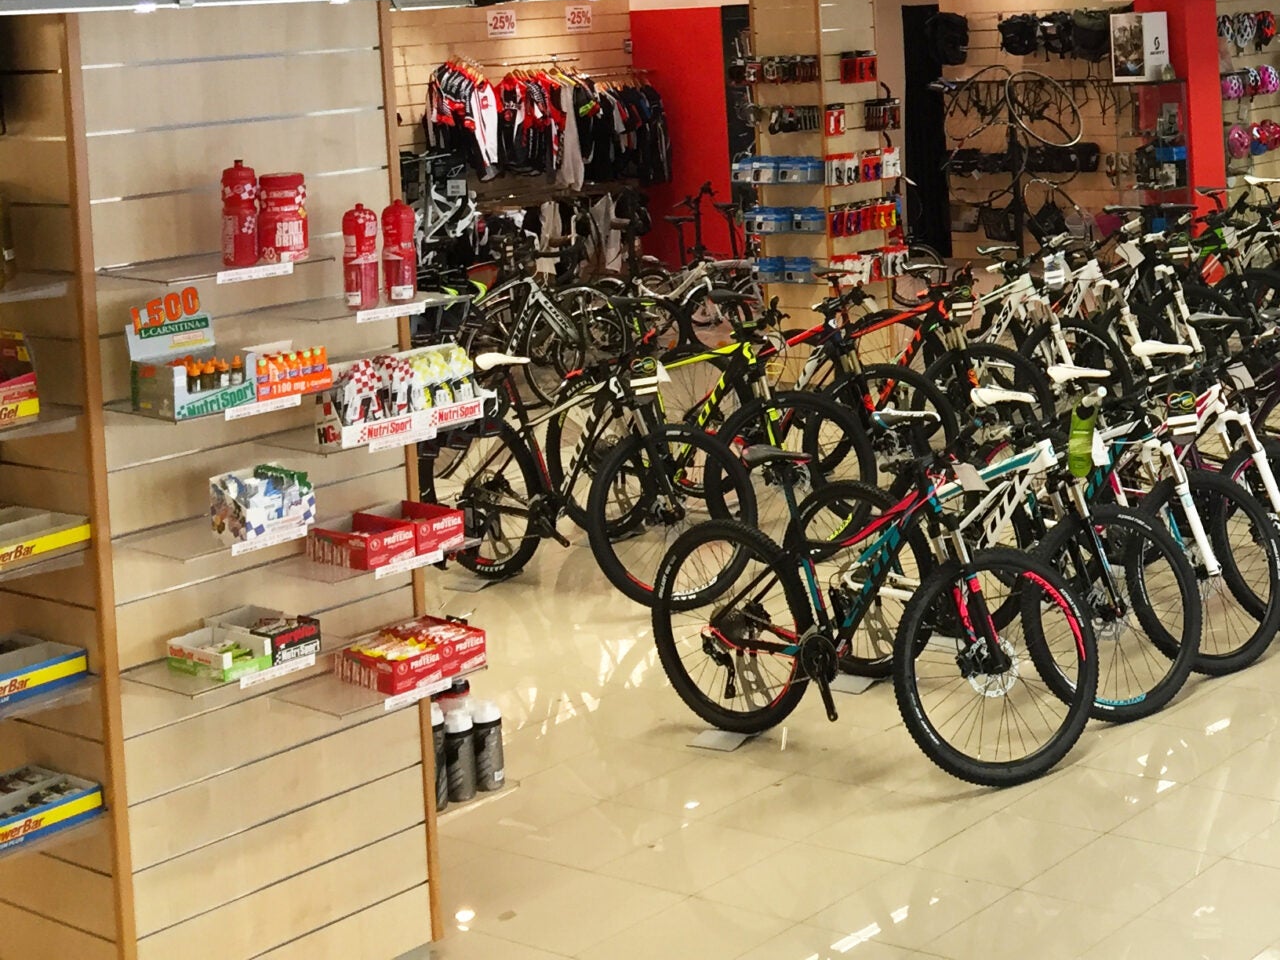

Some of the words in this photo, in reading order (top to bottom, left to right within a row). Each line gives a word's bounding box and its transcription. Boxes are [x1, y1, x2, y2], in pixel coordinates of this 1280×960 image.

[488, 14, 515, 30] -25%
[567, 10, 591, 25] -25%
[275, 219, 304, 235] SPORT
[275, 233, 305, 248] DRINK
[0, 403, 19, 420] Gel
[437, 402, 482, 423] NutriSport
[366, 417, 413, 440] NutriSport
[0, 544, 36, 563] erBar
[0, 677, 31, 696] erBar
